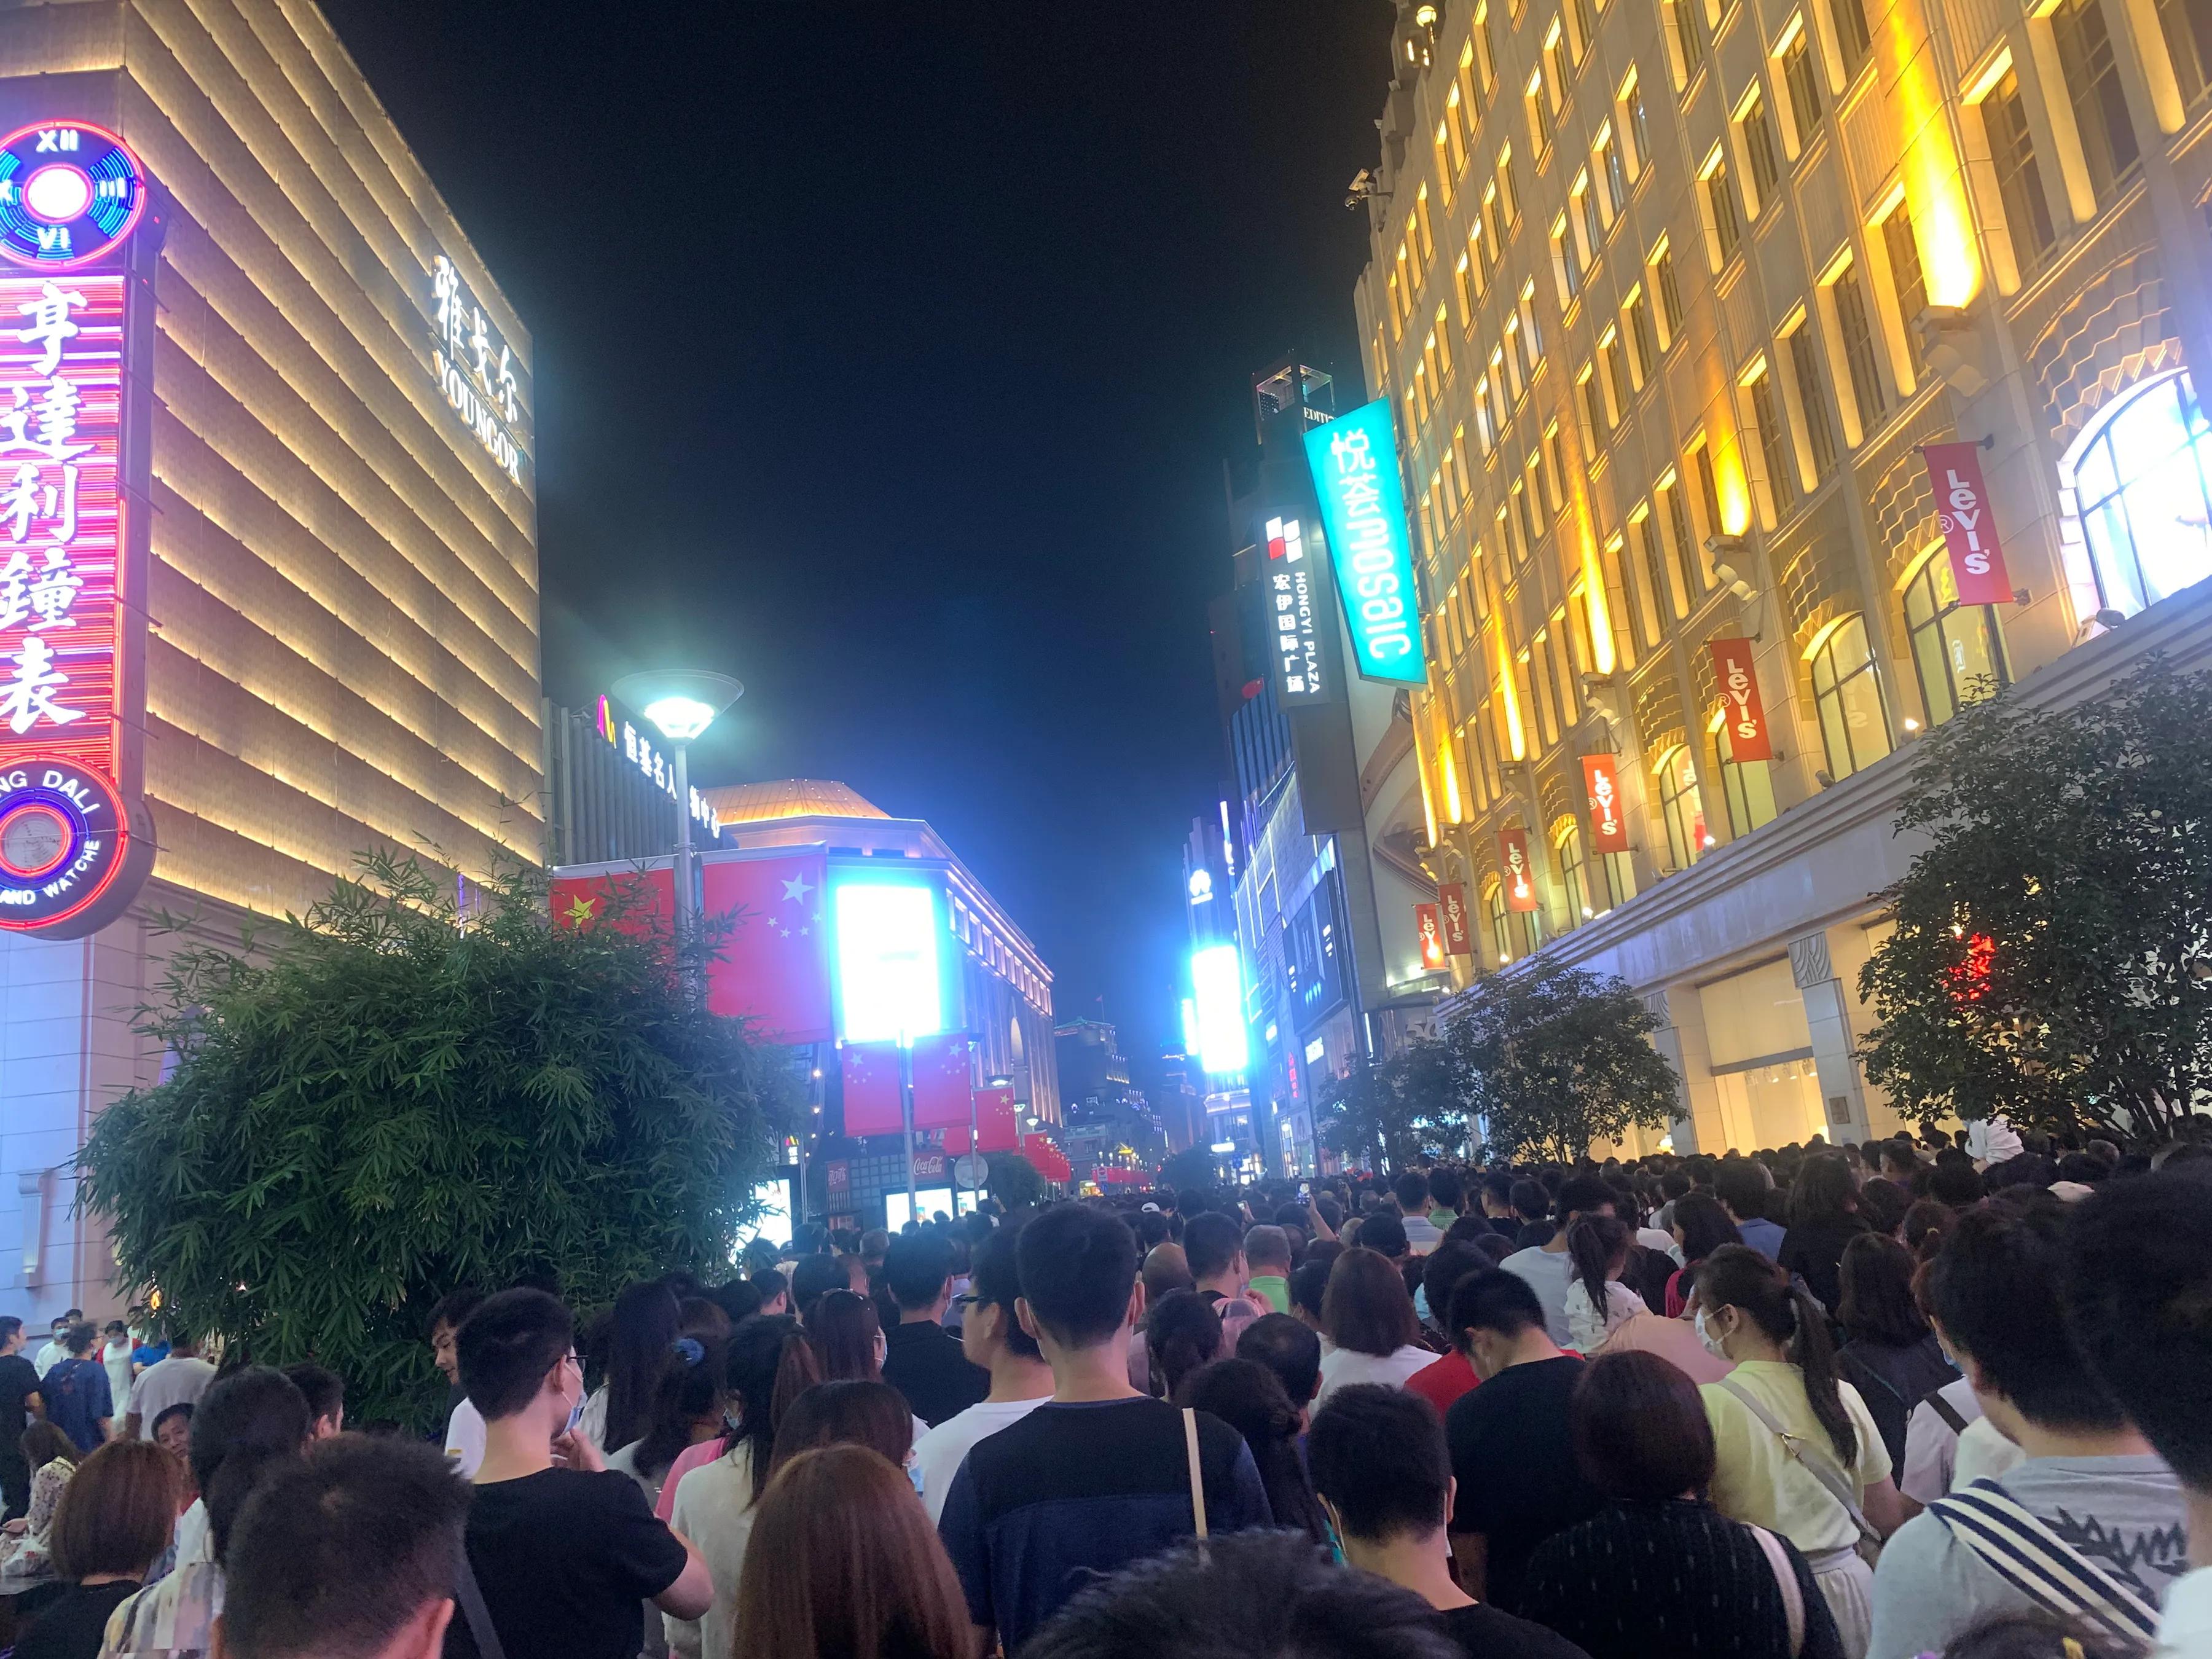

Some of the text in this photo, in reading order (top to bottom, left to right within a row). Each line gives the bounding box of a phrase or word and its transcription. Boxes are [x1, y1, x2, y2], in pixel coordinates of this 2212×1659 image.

[36, 129, 79, 152] XII
[37, 227, 69, 249] VI
[437, 349, 522, 486] YOUNGOR
[1330, 428, 1381, 518] 悦荟
[1273, 574, 1305, 693] 宏伊国际广场
[1295, 571, 1320, 694] HONGYI PLAZA
[1346, 516, 1412, 659] mosaic
[0, 770, 100, 815] NG DALI
